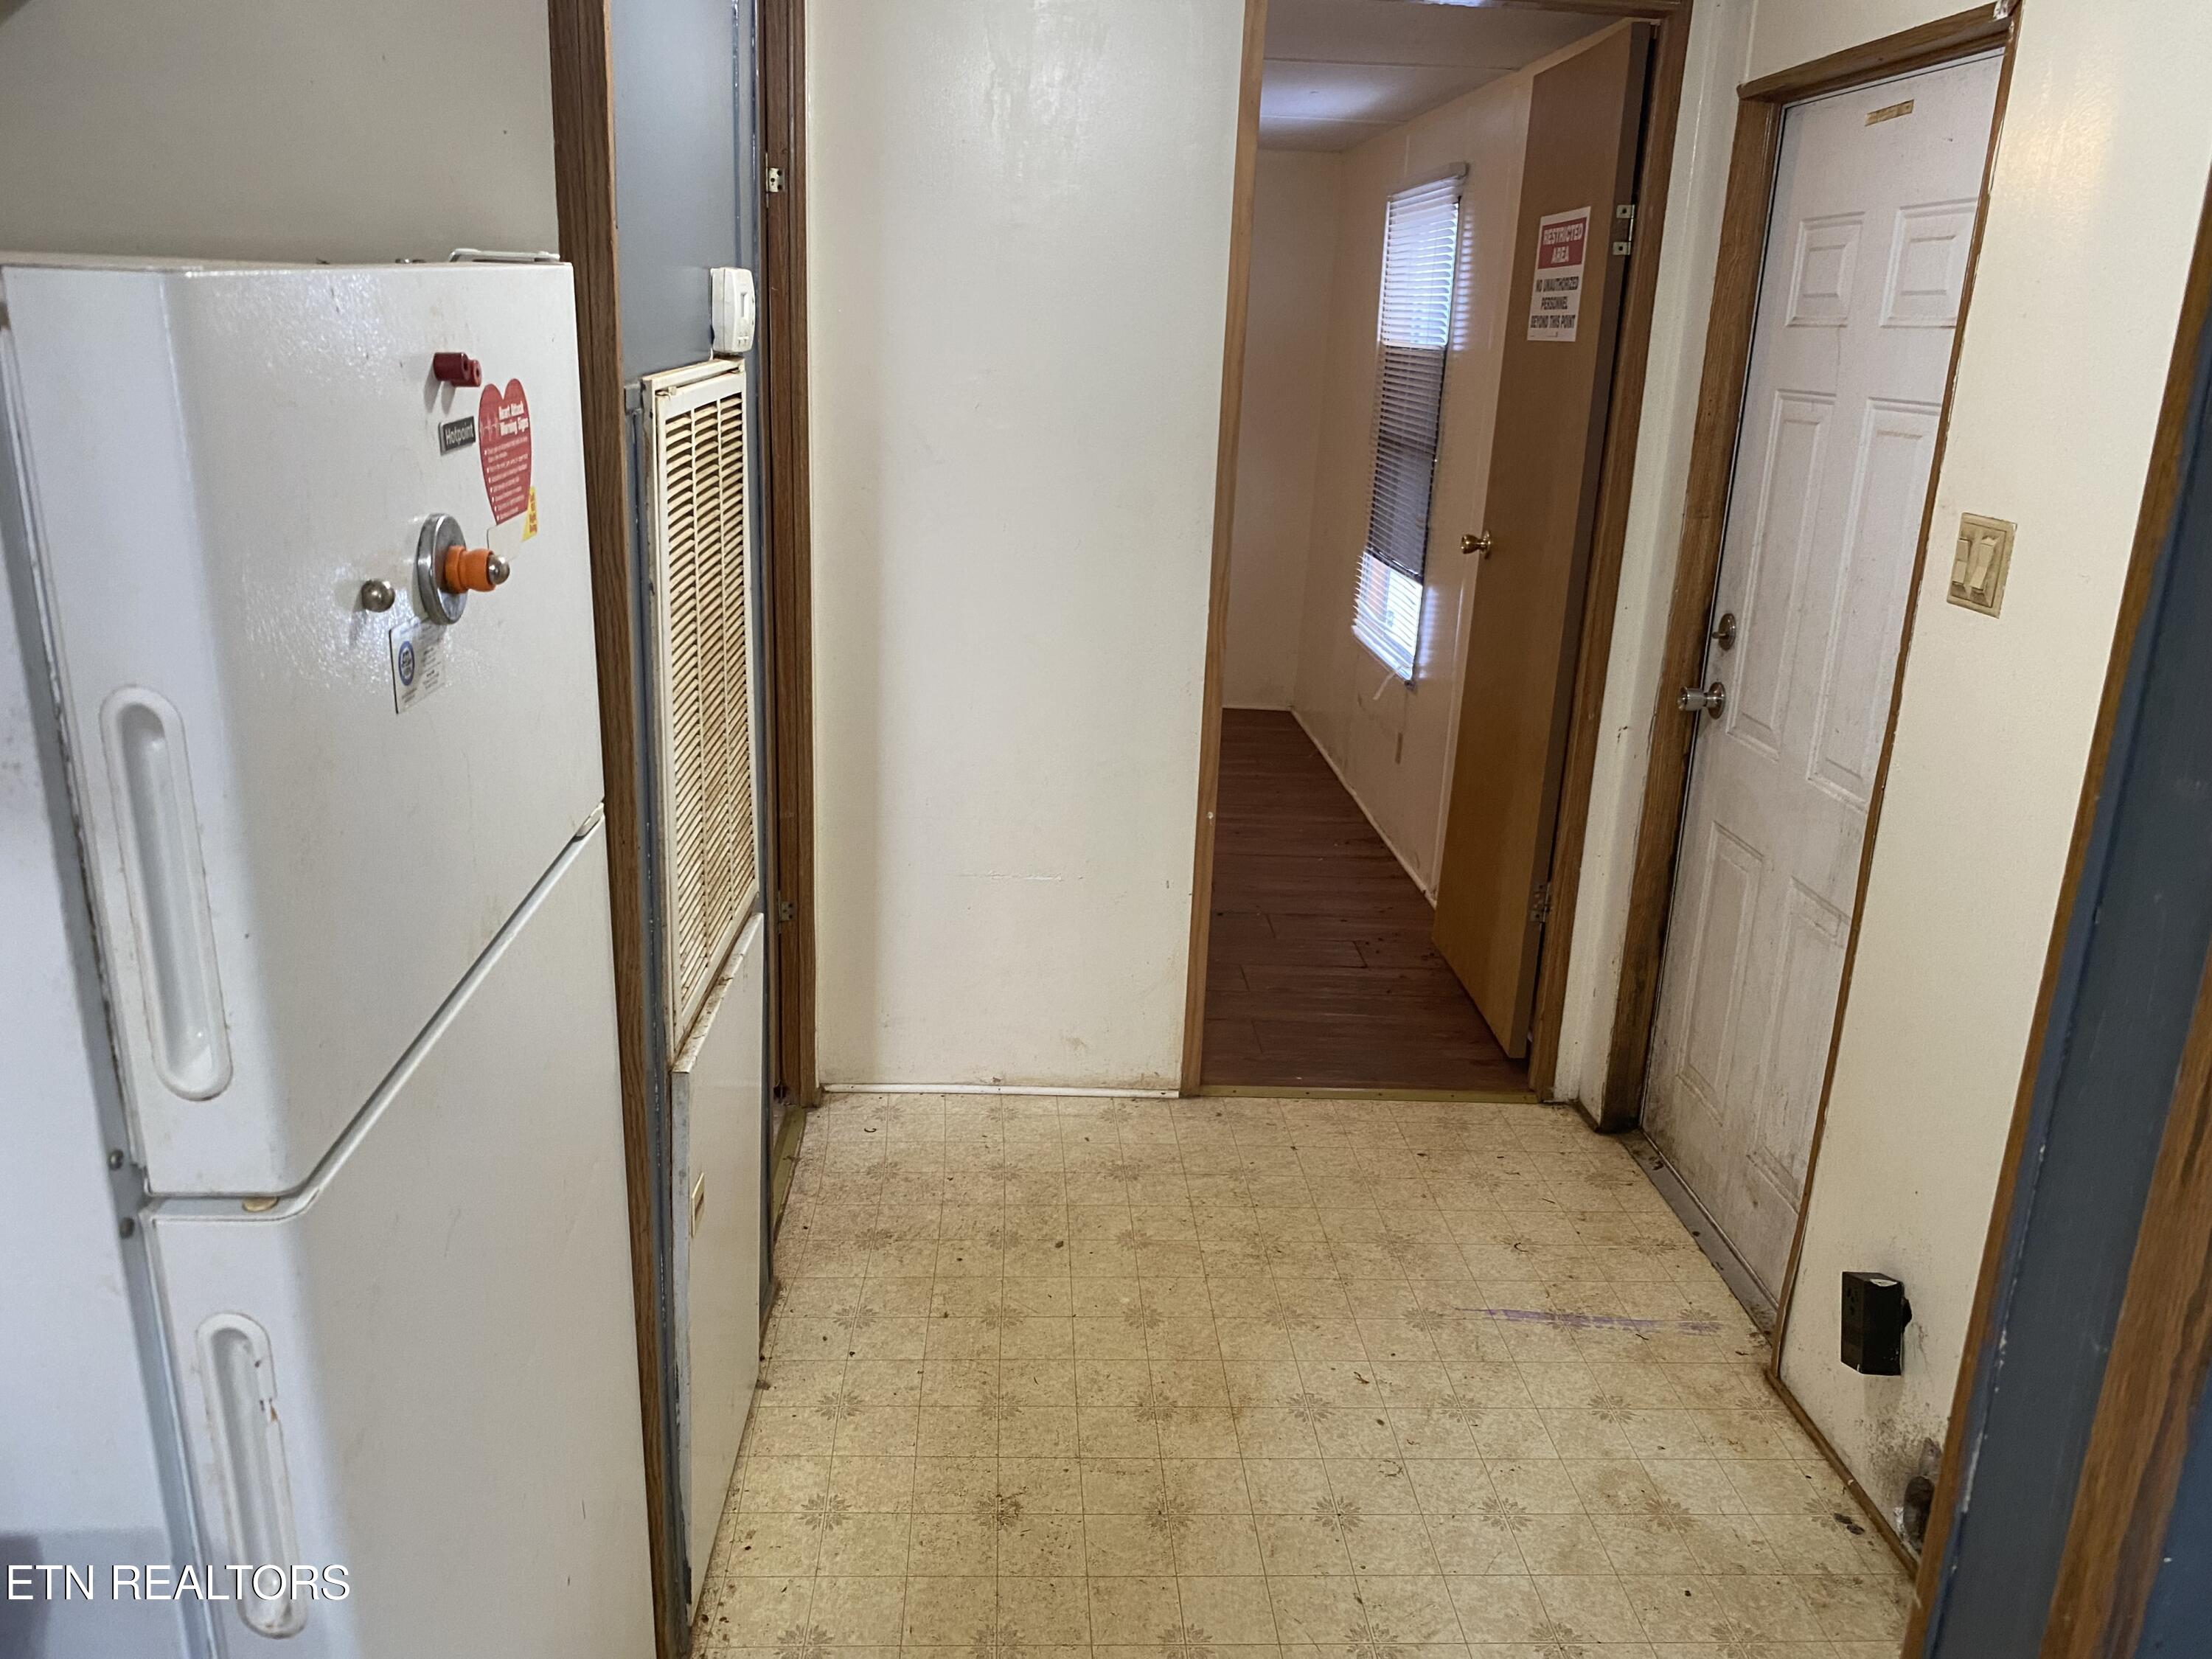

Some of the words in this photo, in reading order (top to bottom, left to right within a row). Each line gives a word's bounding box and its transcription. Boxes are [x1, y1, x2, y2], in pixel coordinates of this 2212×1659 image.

[1543, 223, 1584, 245] RESTRICTED
[1551, 246, 1570, 264] AREA
[1543, 276, 1579, 292] UNAUTHORIZED
[1542, 296, 1568, 310] PERSONNEL
[1560, 315, 1576, 329] POINT
[445, 423, 474, 445] Hotpoint
